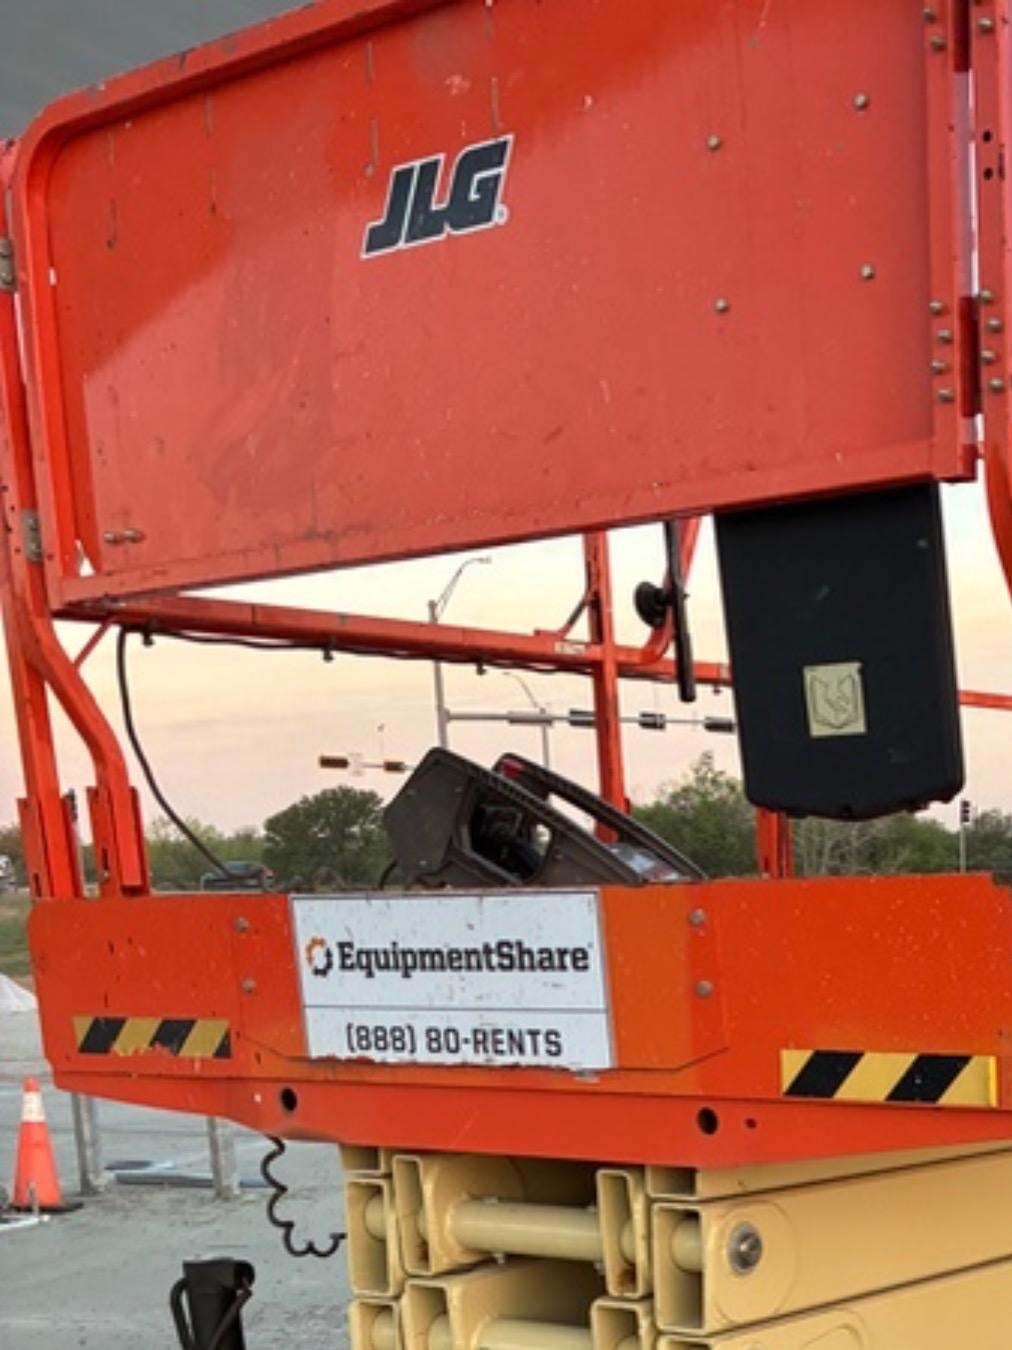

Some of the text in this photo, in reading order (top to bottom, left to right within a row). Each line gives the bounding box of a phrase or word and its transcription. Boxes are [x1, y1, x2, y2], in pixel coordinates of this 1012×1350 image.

[360, 133, 514, 260] JLG
[336, 940, 589, 978] EquipmentShare
[346, 1024, 563, 1057] (888) 80-RENTS
